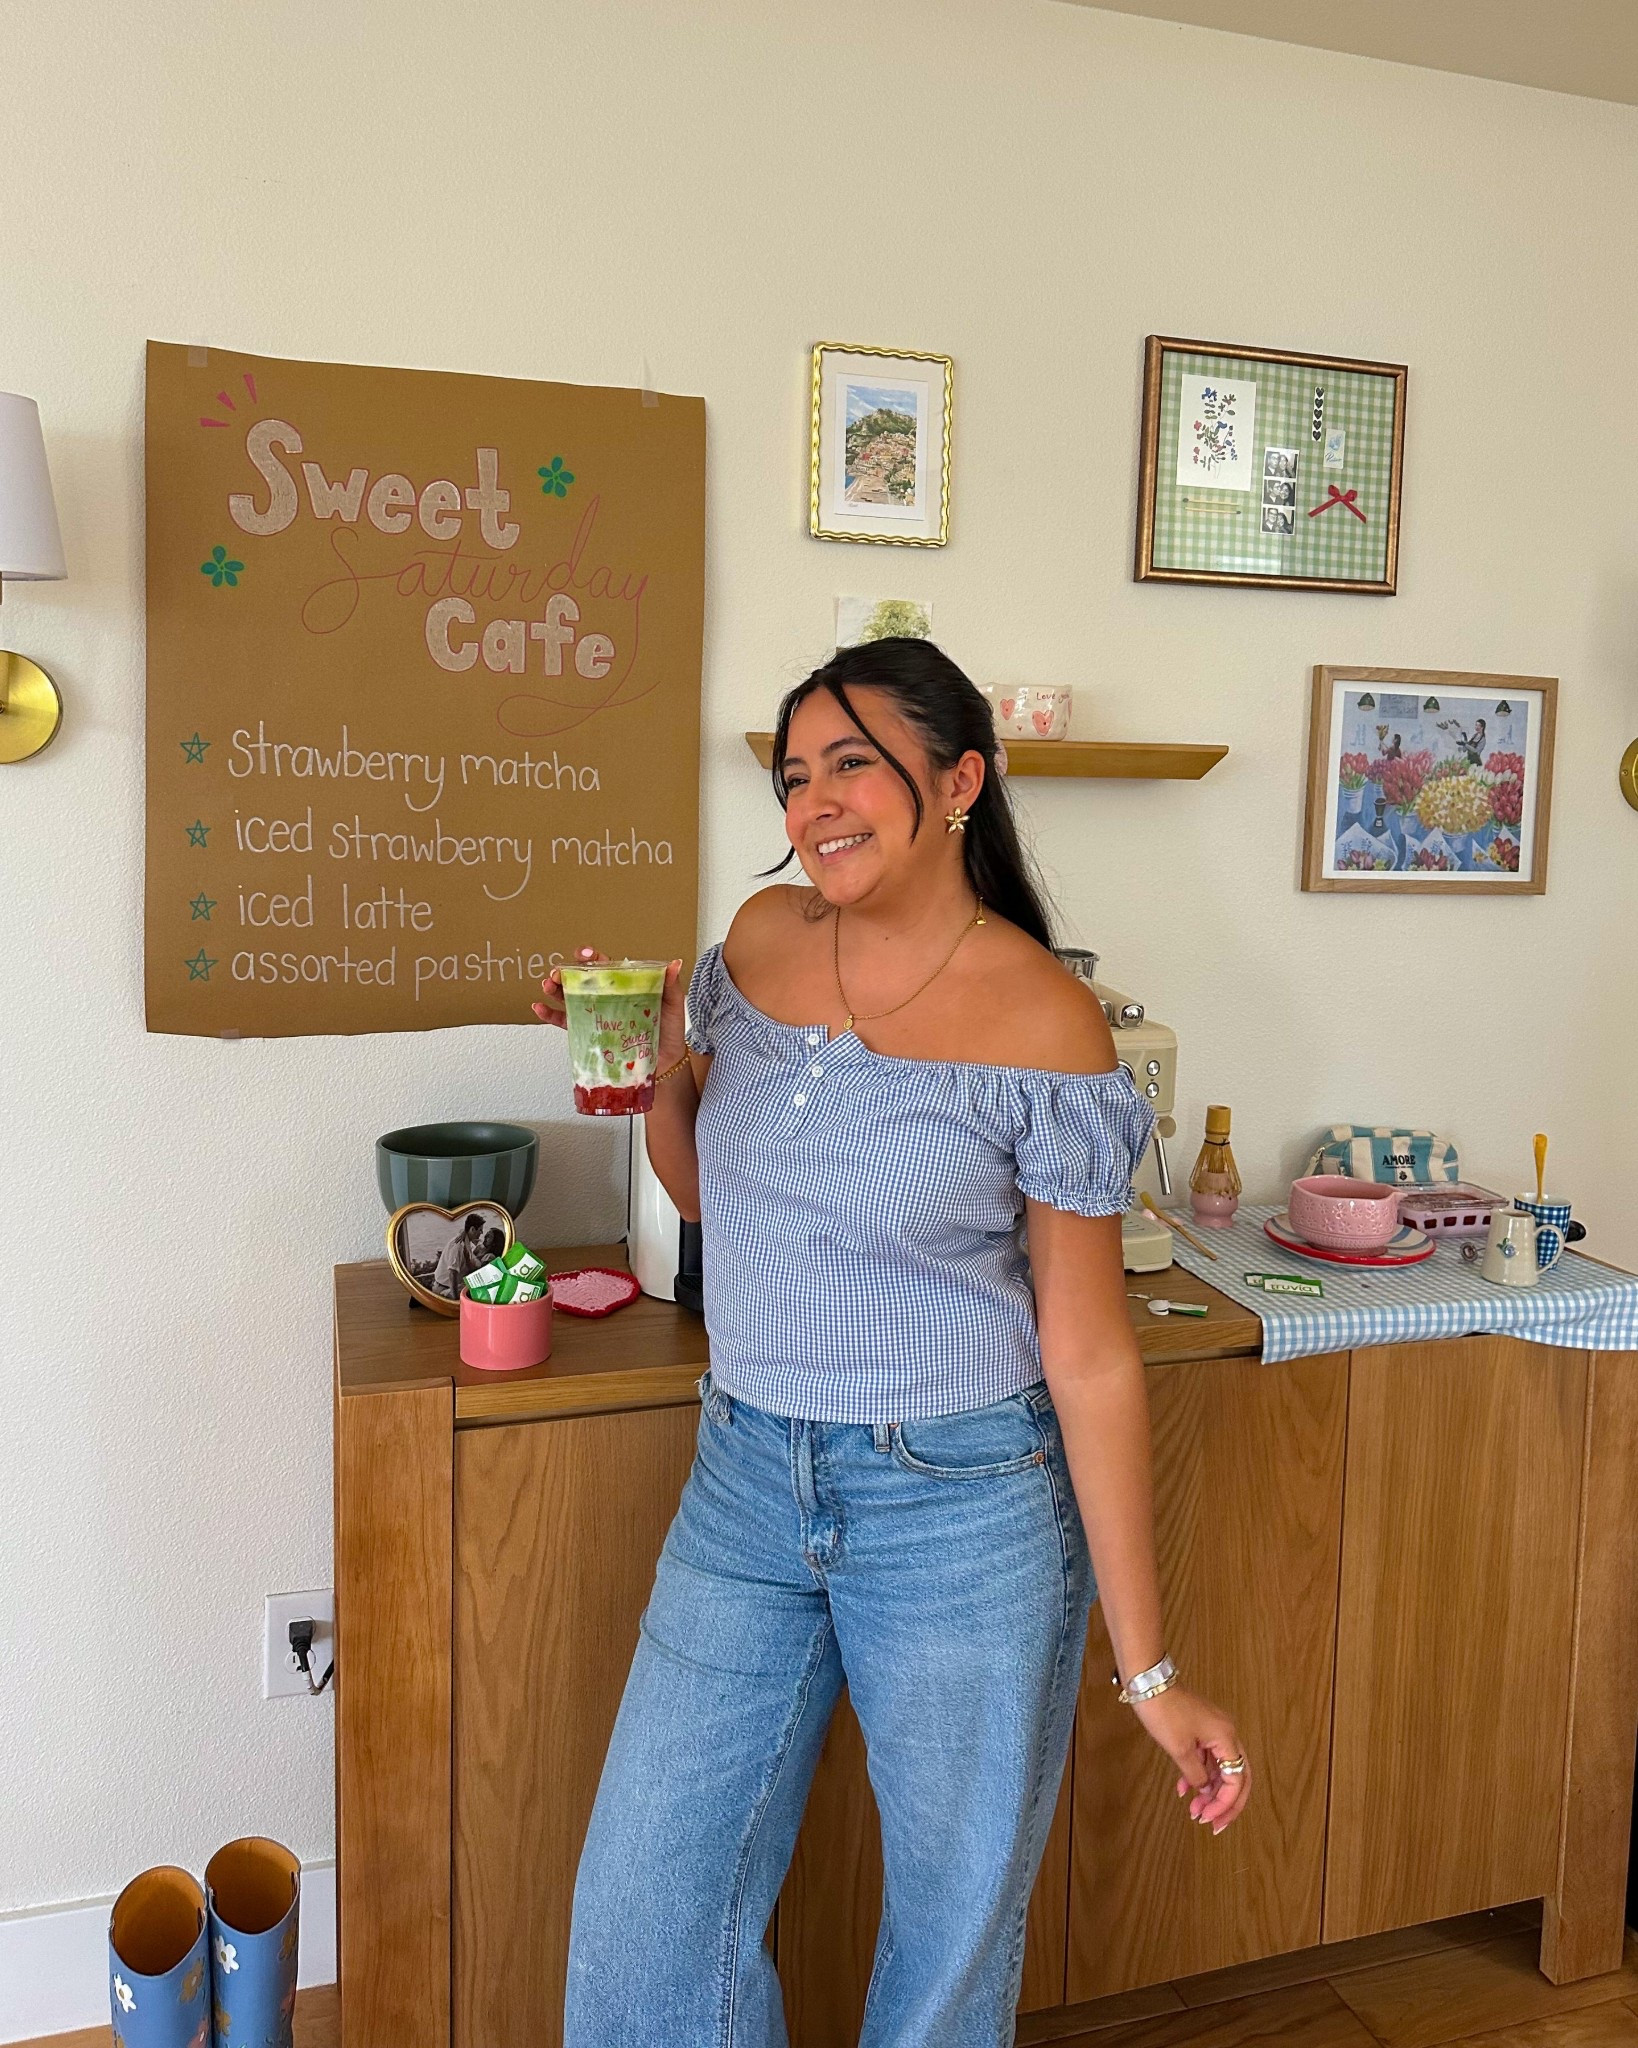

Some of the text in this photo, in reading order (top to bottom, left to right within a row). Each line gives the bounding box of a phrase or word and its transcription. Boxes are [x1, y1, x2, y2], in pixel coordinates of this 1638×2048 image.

[228, 418, 521, 550] Sweet
[302, 493, 662, 737] Saturday
[424, 593, 616, 679] Cafe
[461, 751, 601, 792] matcha
[235, 806, 313, 853] iced
[552, 828, 673, 867] matcha
[238, 875, 434, 932] iced latte
[231, 947, 396, 987] assorted
[596, 1014, 637, 1031] Have a
[1382, 1154, 1416, 1166] AMORE
[1271, 1283, 1314, 1293] truvia
